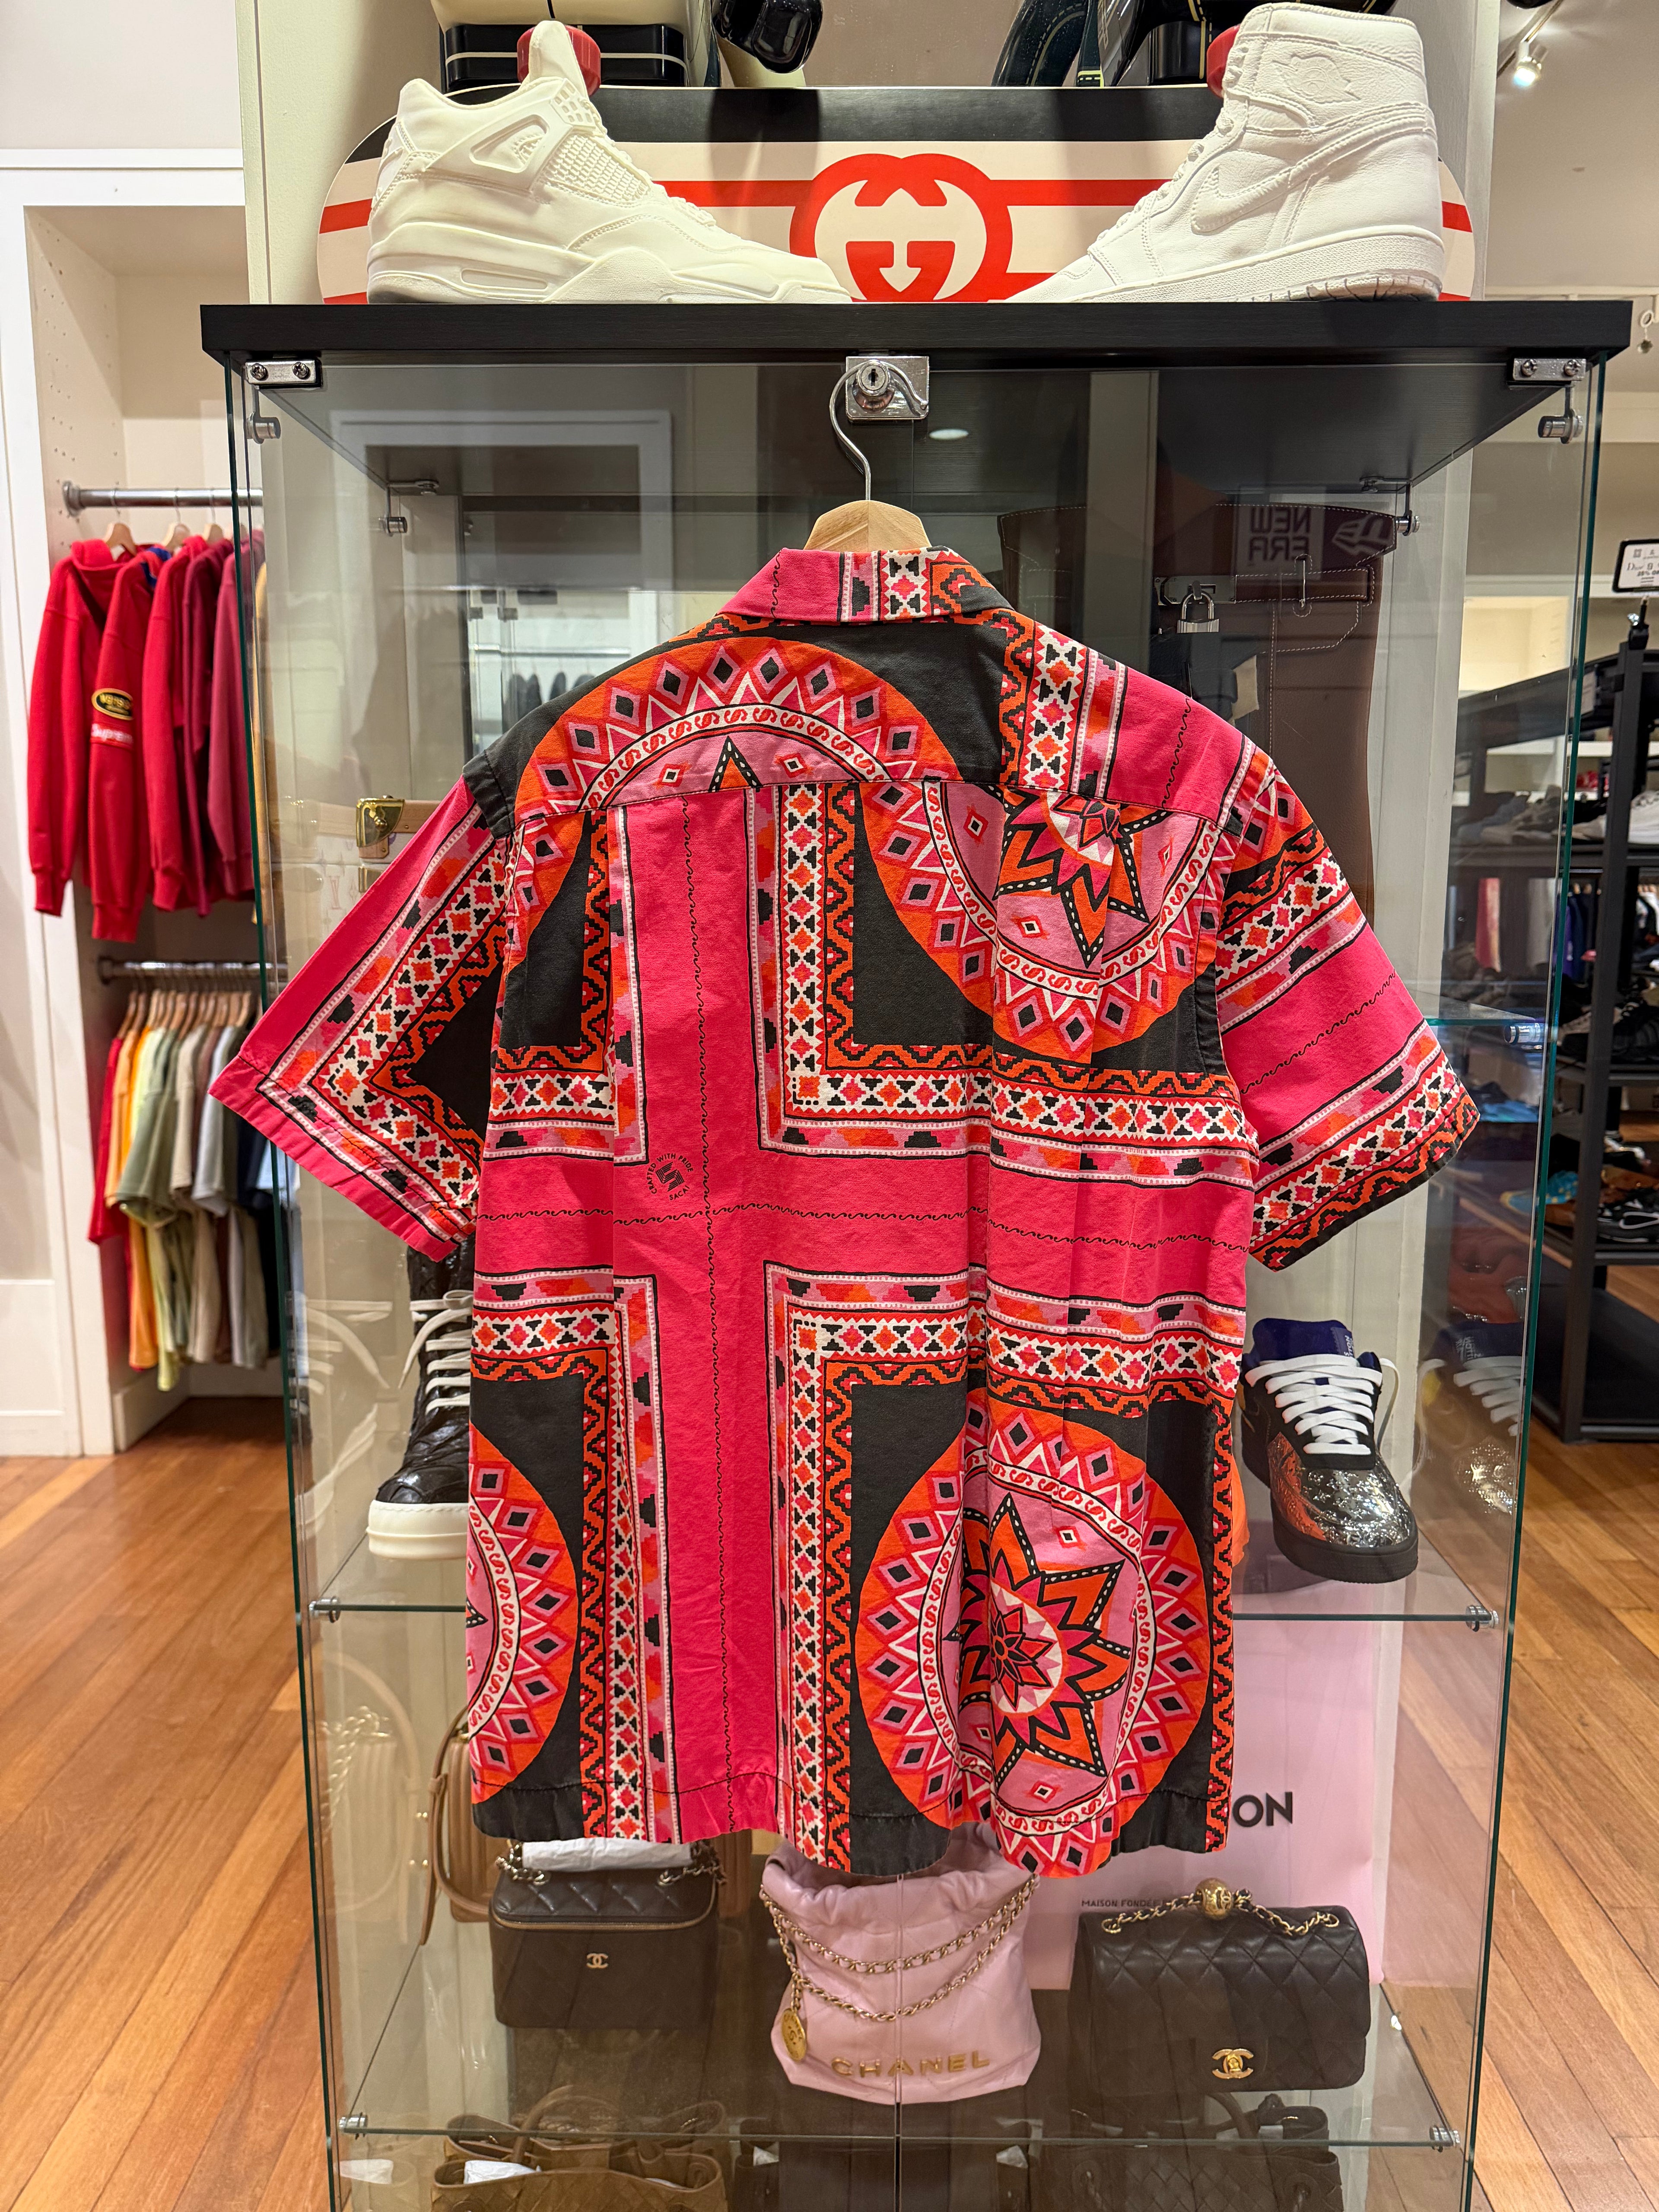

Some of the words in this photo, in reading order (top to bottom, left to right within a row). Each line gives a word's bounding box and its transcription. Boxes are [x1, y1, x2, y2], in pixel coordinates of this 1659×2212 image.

[646, 1163, 657, 1194] CRAFTED
[656, 1153, 676, 1162] WITH
[678, 1155, 693, 1172] PRIDE
[669, 1185, 690, 1200] SACAI
[831, 2050, 990, 2078] CHANEL
